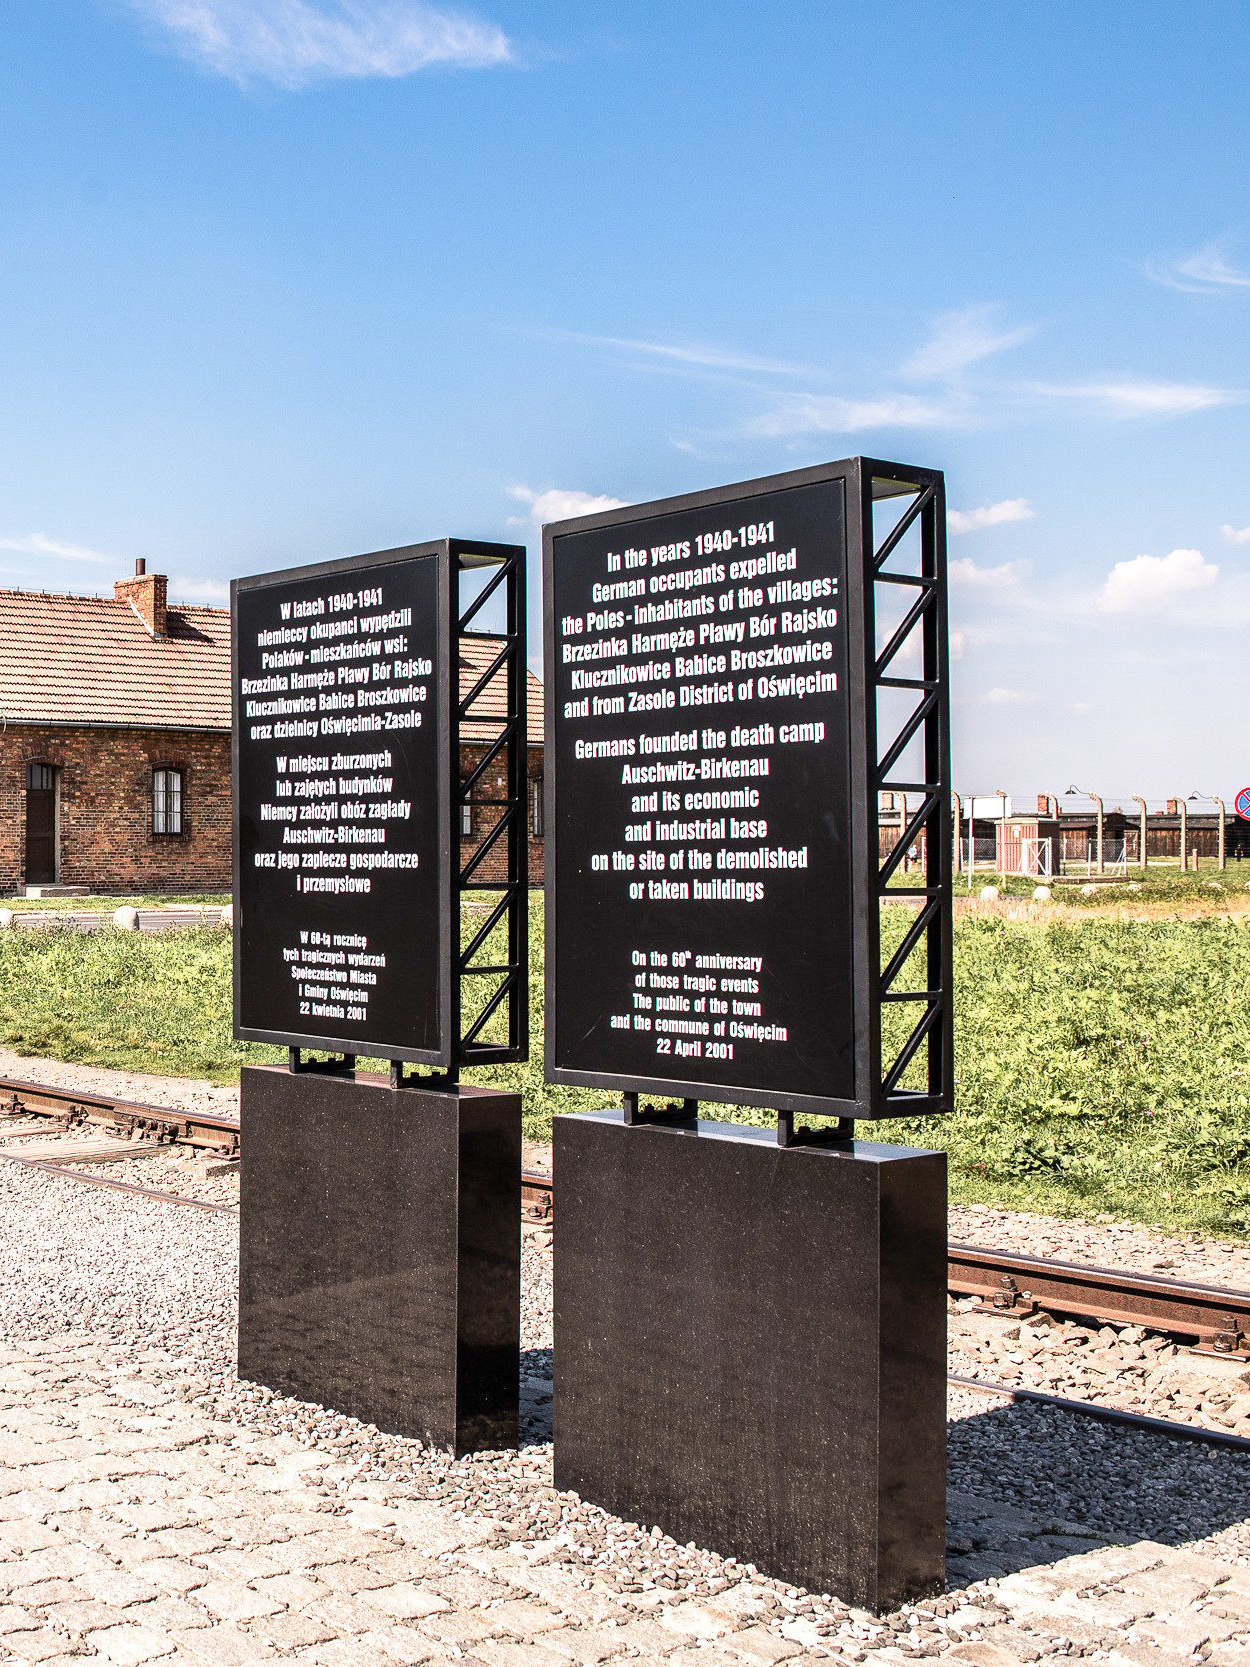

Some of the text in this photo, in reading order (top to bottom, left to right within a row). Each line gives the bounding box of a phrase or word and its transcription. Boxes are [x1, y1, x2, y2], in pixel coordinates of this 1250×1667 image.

[608, 521, 774, 572] In the years 1940-1941
[593, 548, 796, 603] German occupants expelled
[280, 588, 382, 620] W latach 1940-1941
[562, 616, 583, 636] the
[587, 610, 624, 632] Poles
[634, 595, 714, 624] inhabitants
[719, 590, 733, 611] of
[738, 587, 763, 609] the
[767, 578, 837, 604] villages:
[258, 608, 411, 646] niemieccy okupanci wypędzili
[563, 607, 837, 663] Brzezinka Harmęże Pławy Bór Rajsko
[262, 649, 304, 669] Polaków
[311, 639, 381, 663] mieszkańców
[384, 635, 407, 654] wsi:
[242, 658, 432, 694] Brzezinka Harmęże Pławy Bór Rajsko
[572, 640, 832, 690] Klucznikowice Babice Broszkowice
[247, 684, 426, 717] Klucznikowice Babice Broszkowice
[564, 671, 837, 718] and from Zasole District of Oświęcim
[251, 710, 421, 739] oraz dzielnicy Oświęcimia-Zasole
[576, 722, 824, 759] Germans founded the death camp
[277, 750, 391, 774] W miejscu zburzonych
[622, 757, 769, 784] Auschwitz-Birkenau
[277, 775, 393, 799] lub zajętych budynków
[261, 800, 411, 822] Niemcy założyli obóz zagłady
[632, 787, 759, 812] and its economic
[283, 826, 385, 844] Auschwitz-Birkenau
[625, 818, 767, 841] and industrial base
[255, 851, 418, 870] oraz jego zaplecze gospodarcze
[592, 847, 807, 870] on the site of the demolished
[296, 875, 370, 894] i przemysłowe
[630, 879, 764, 902] or taken buildings
[300, 931, 308, 943] W
[334, 934, 367, 950] rocznicę
[283, 948, 299, 961] tych
[302, 949, 345, 965] tragicznych
[632, 950, 646, 966] On
[650, 951, 667, 966] the
[696, 953, 762, 972] anniversary
[350, 970, 376, 984] Miasta
[635, 972, 758, 993] of those tragic events
[298, 984, 368, 1003] i Gminy Oświęcim
[633, 993, 761, 1016] The public of the town
[300, 1002, 366, 1020] 22 kwietnia 2001
[611, 1014, 787, 1042] and the commune of Oświęcim
[657, 1038, 733, 1059] 22 April 2001
